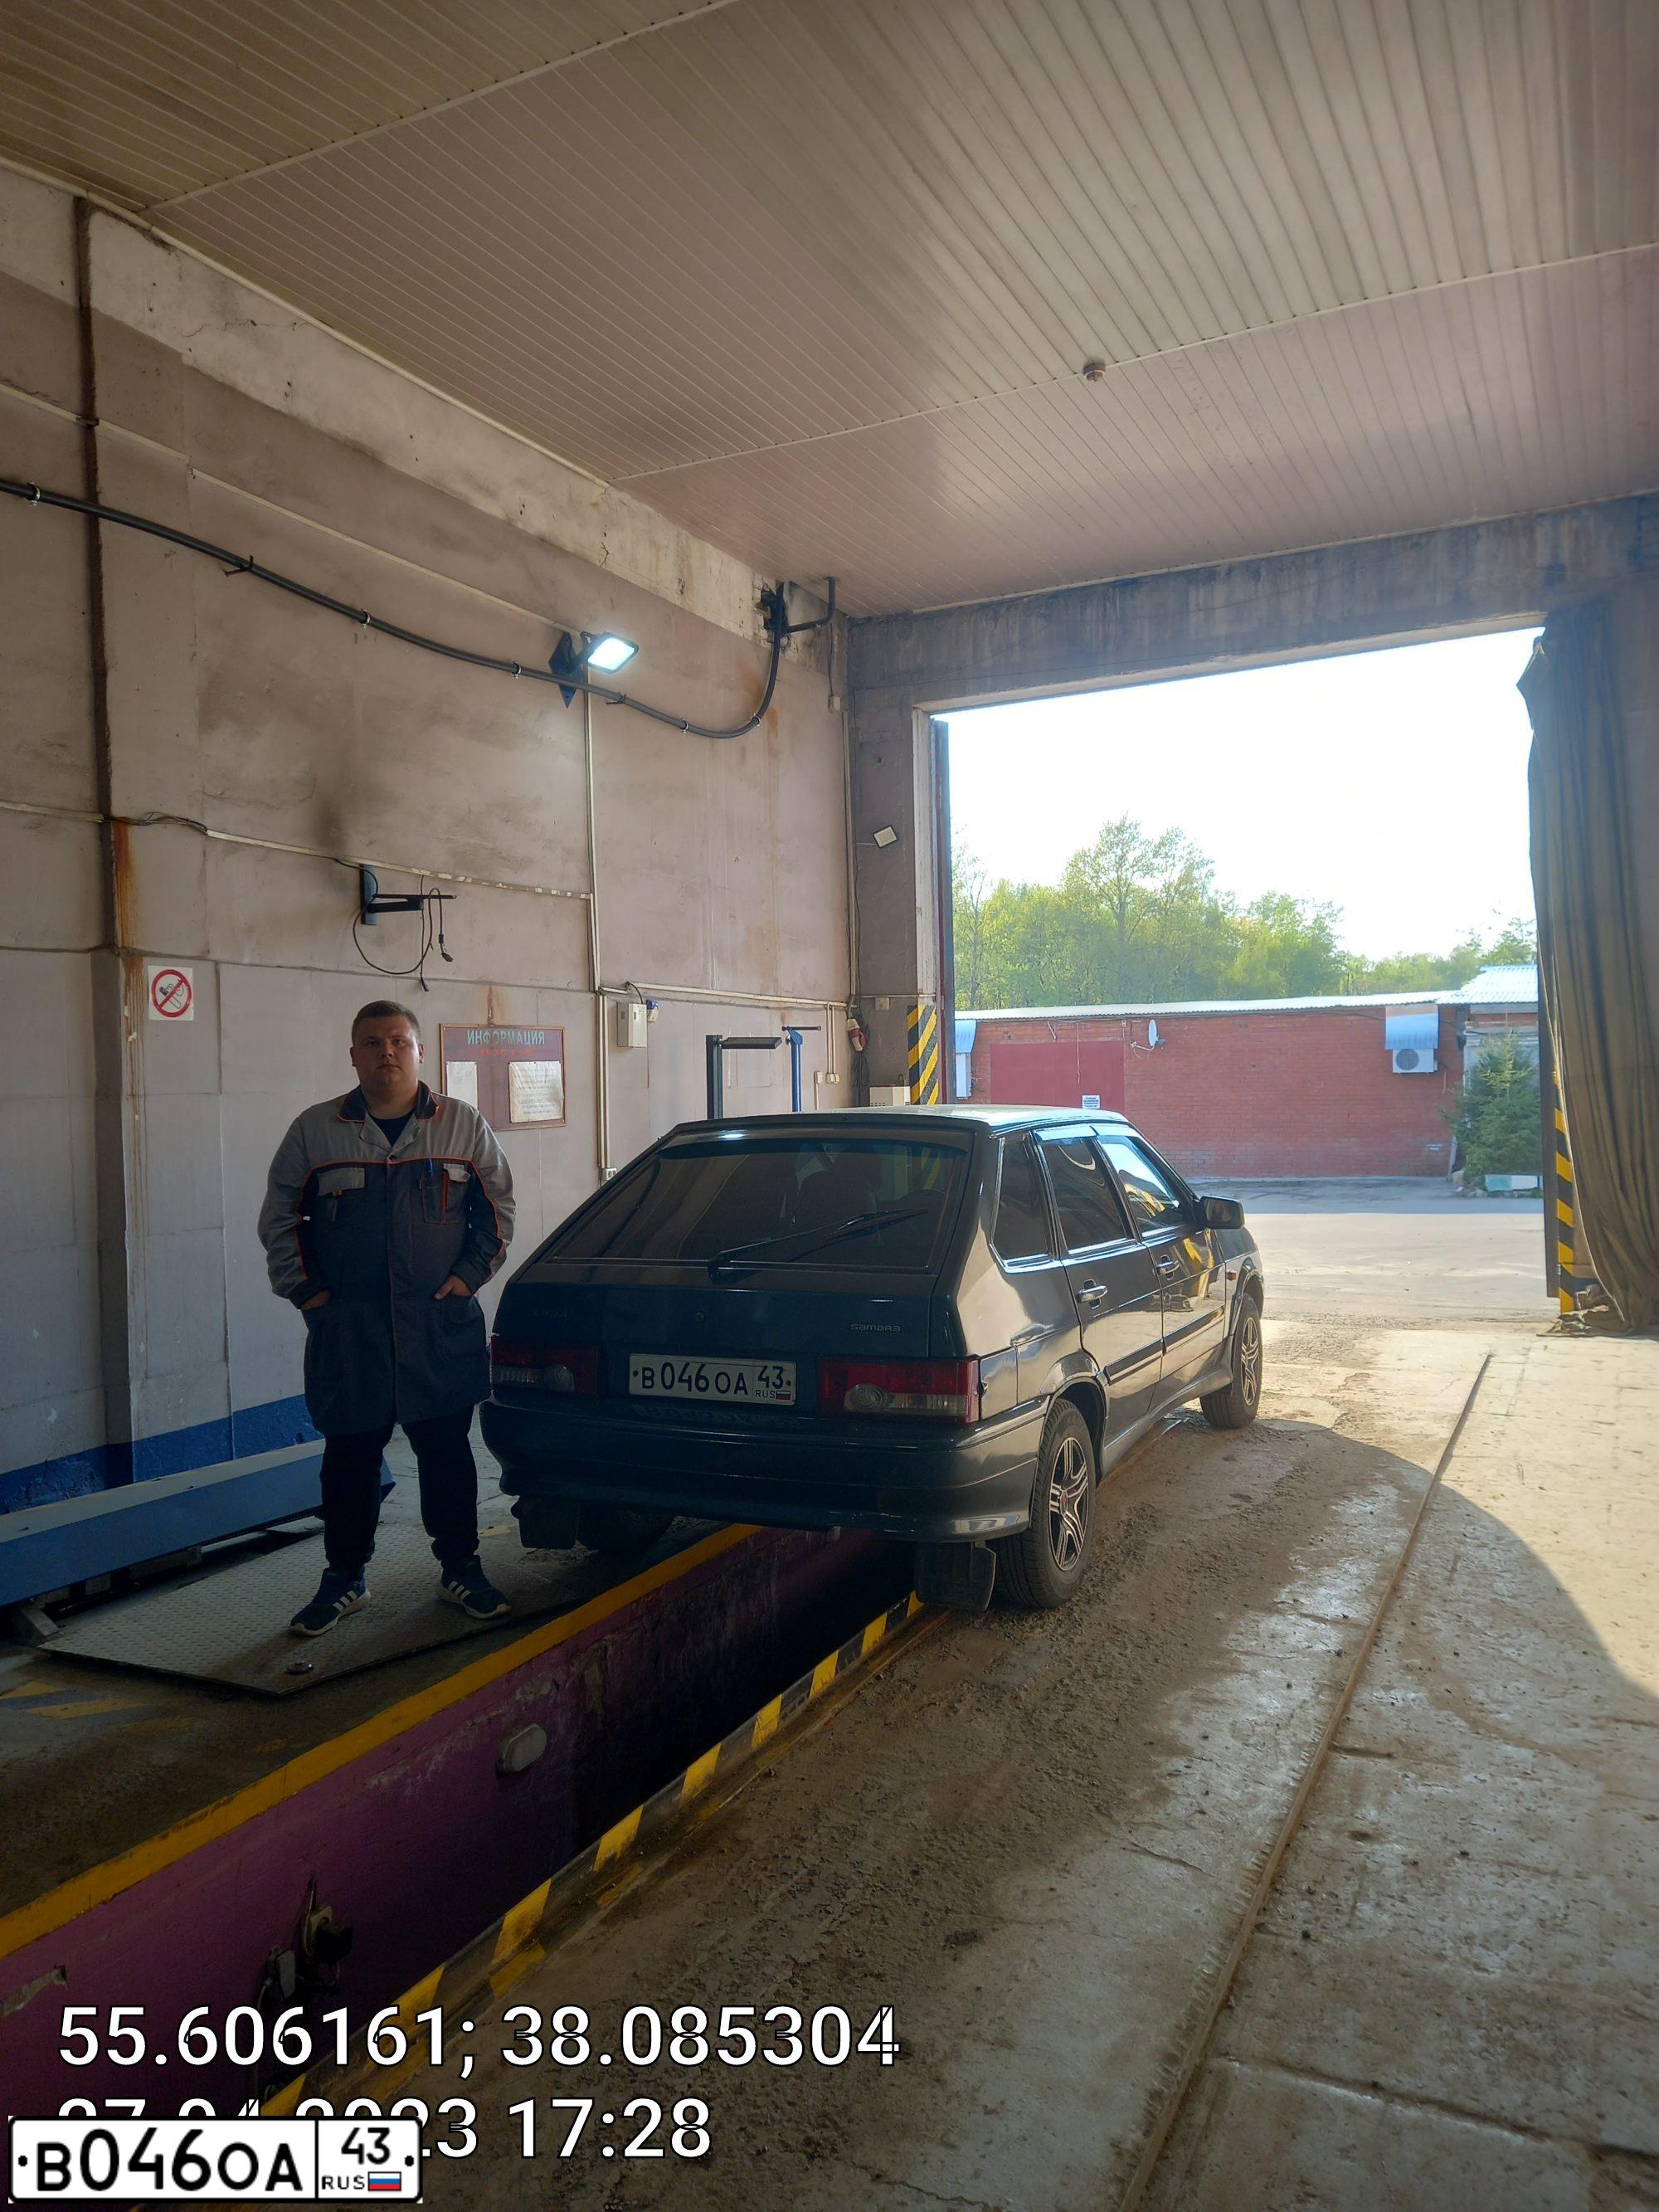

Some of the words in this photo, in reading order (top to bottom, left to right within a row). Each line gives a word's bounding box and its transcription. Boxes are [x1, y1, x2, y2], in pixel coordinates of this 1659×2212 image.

[466, 1030, 546, 1046] ИНФОРМАЦИЯ
[757, 1365, 784, 1389] 43
[755, 1389, 776, 1399] RUS
